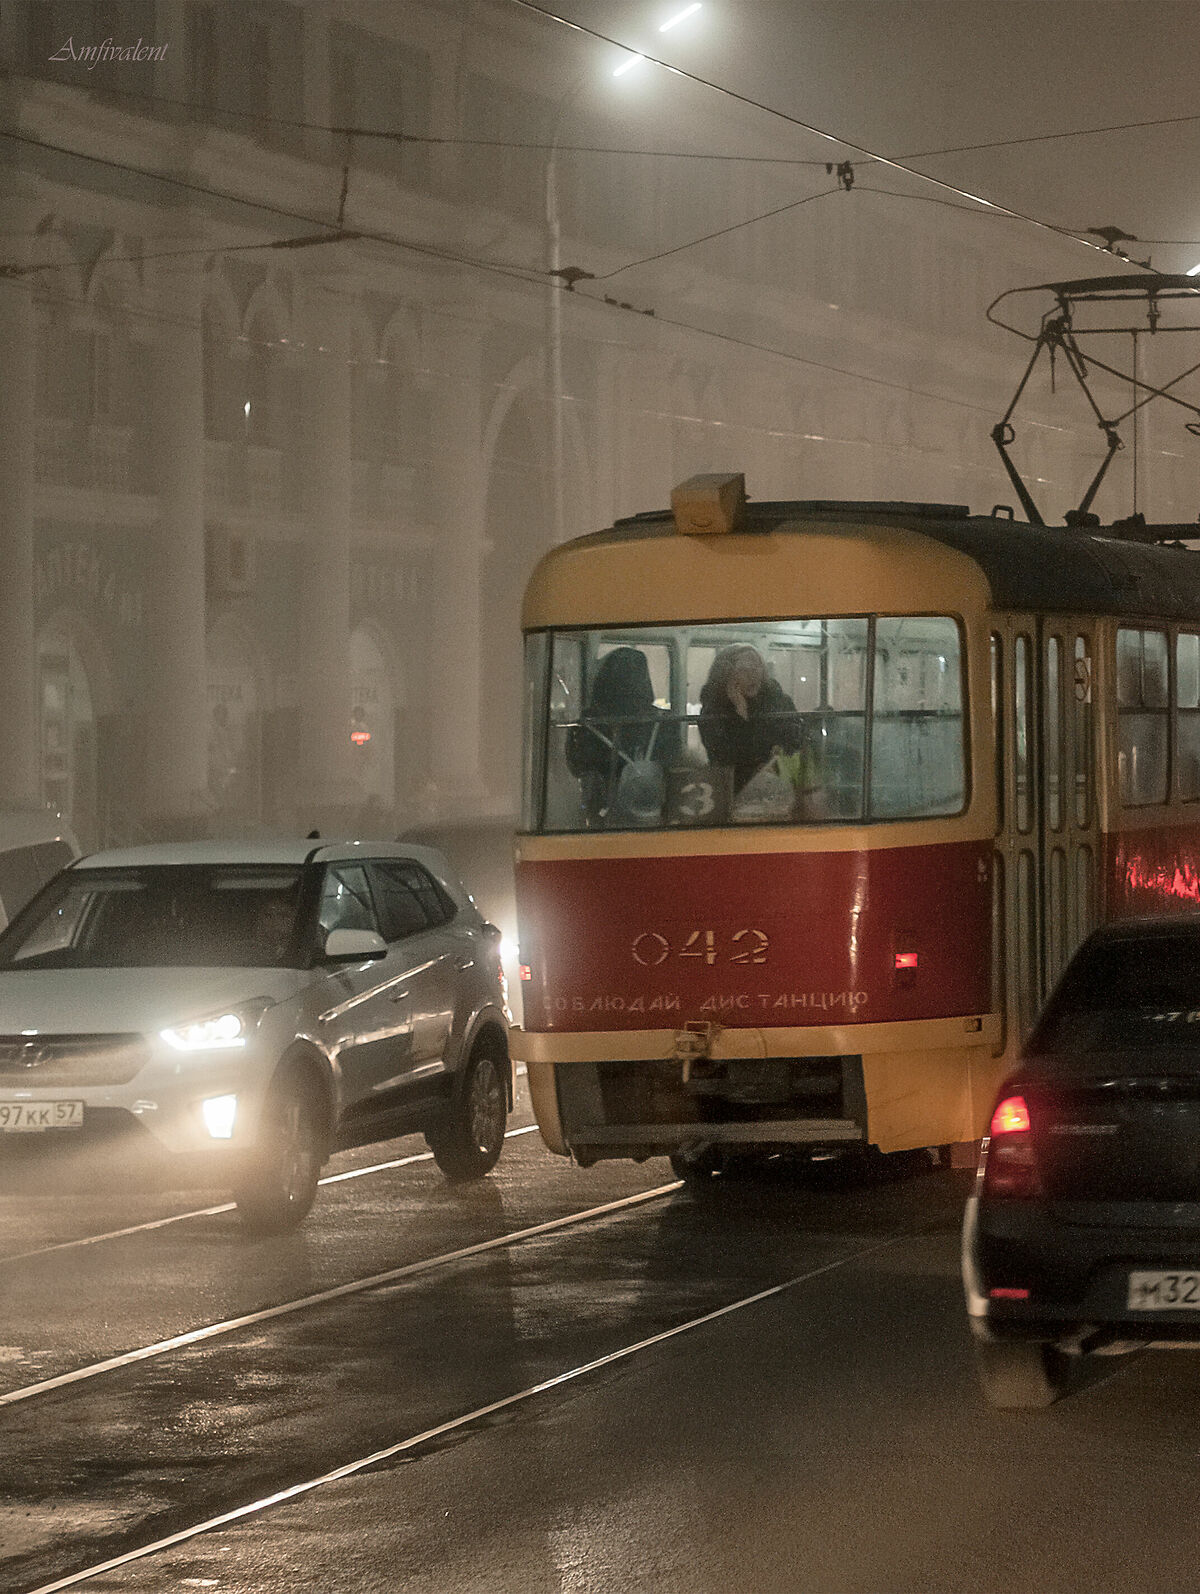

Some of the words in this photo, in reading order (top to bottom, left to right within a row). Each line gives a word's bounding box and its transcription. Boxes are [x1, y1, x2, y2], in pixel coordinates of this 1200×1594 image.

[680, 783, 714, 816] 3
[632, 929, 769, 965] 042
[543, 992, 681, 1012] СОБЛЮДАЙ
[700, 991, 868, 1011] ДИСТАНЦИЮ
[0, 1105, 49, 1126] 97КК
[56, 1103, 76, 1119] 57
